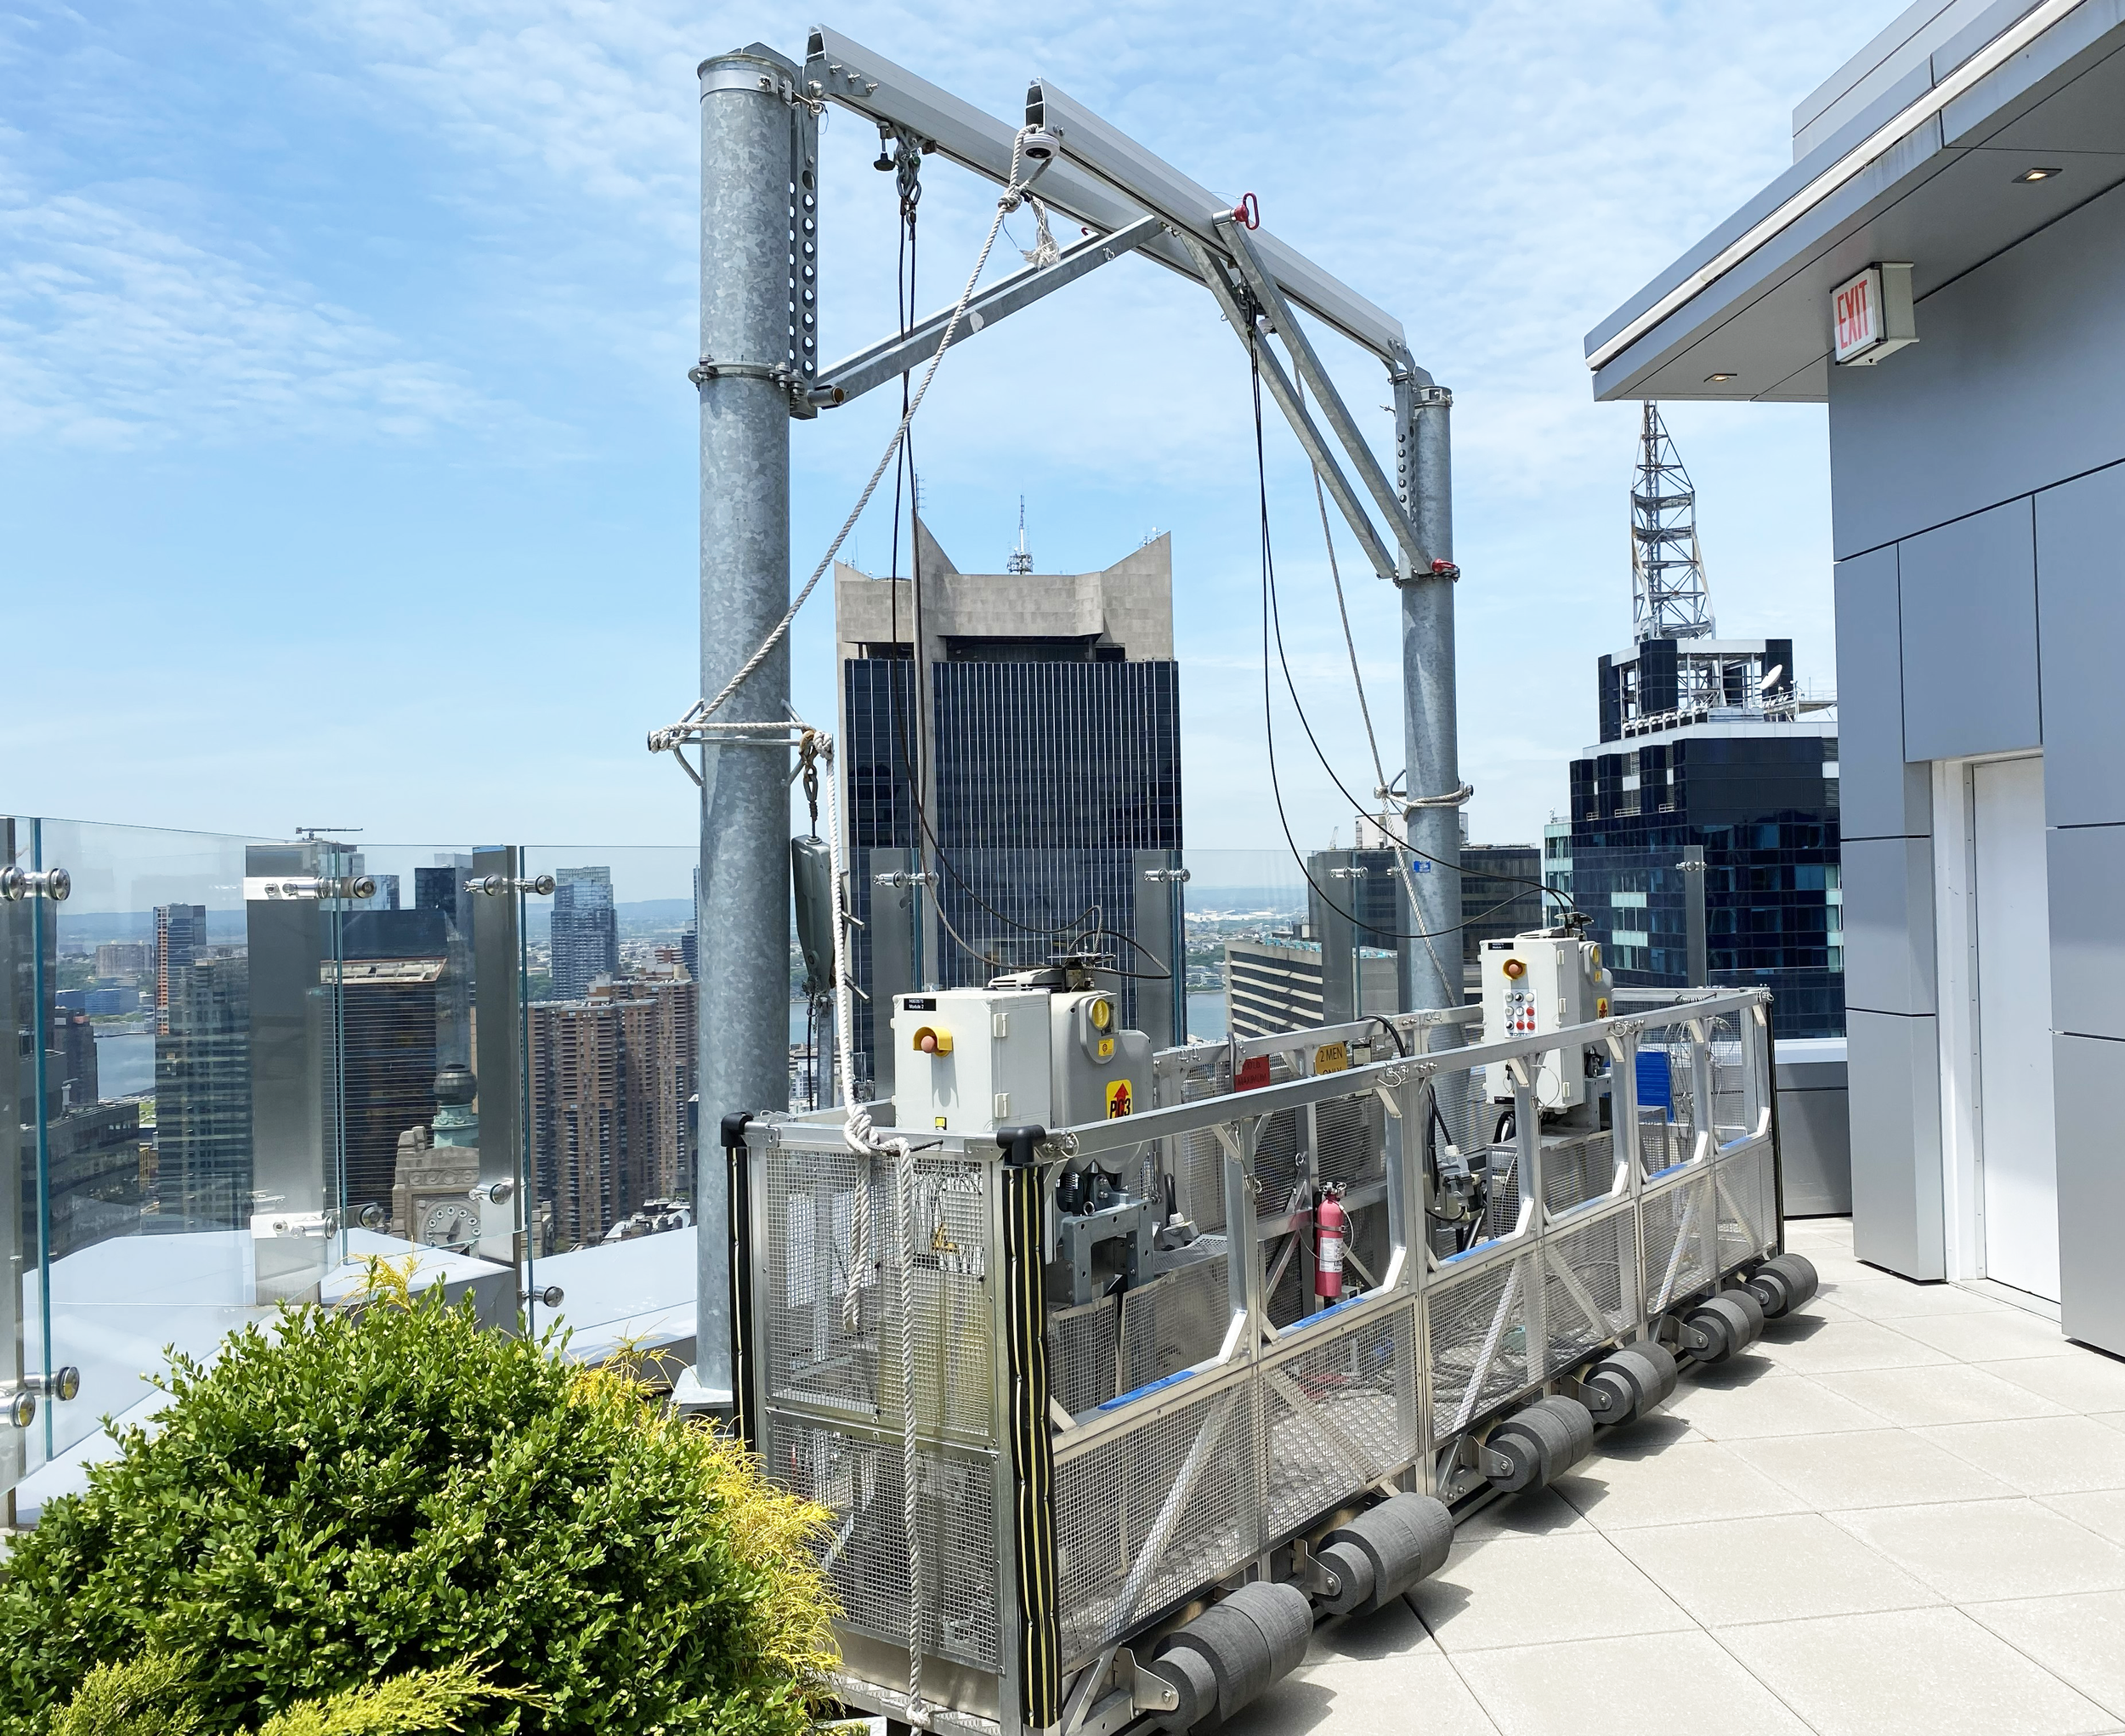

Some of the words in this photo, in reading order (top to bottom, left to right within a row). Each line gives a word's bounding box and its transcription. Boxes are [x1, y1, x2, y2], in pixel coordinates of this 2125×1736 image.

[1837, 279, 1868, 349] EXIT
[1319, 1050, 1325, 1062] 2
[1326, 1047, 1343, 1061] MEN
[1238, 1073, 1266, 1086] MAXIMUM
